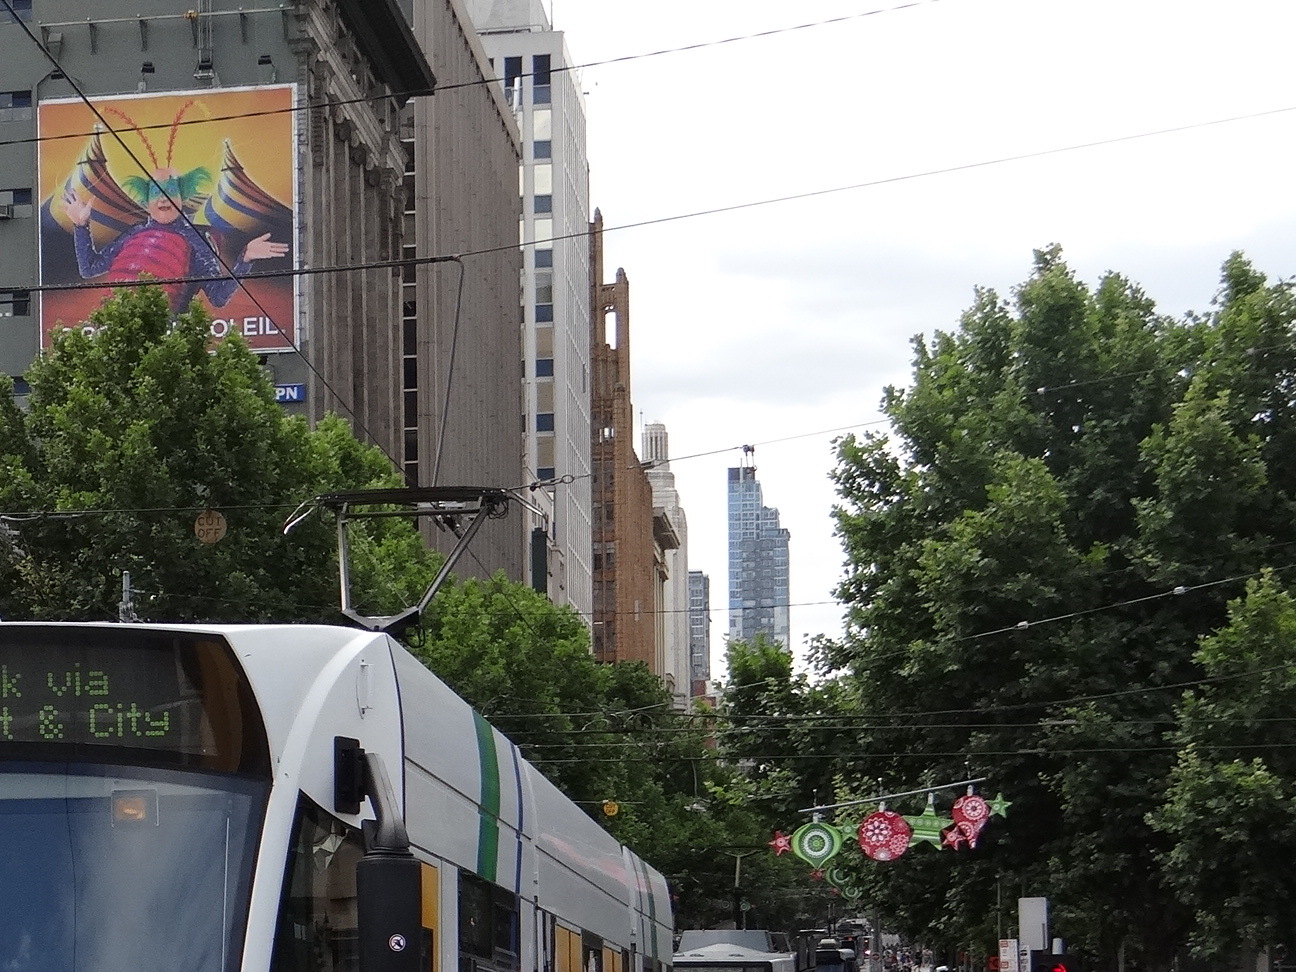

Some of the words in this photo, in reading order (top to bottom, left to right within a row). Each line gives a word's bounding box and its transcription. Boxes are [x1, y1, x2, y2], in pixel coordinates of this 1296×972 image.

[210, 316, 286, 338] OEIL.
[275, 386, 298, 400] PN
[47, 662, 109, 697] via
[39, 705, 64, 740] &
[88, 702, 170, 738] City
